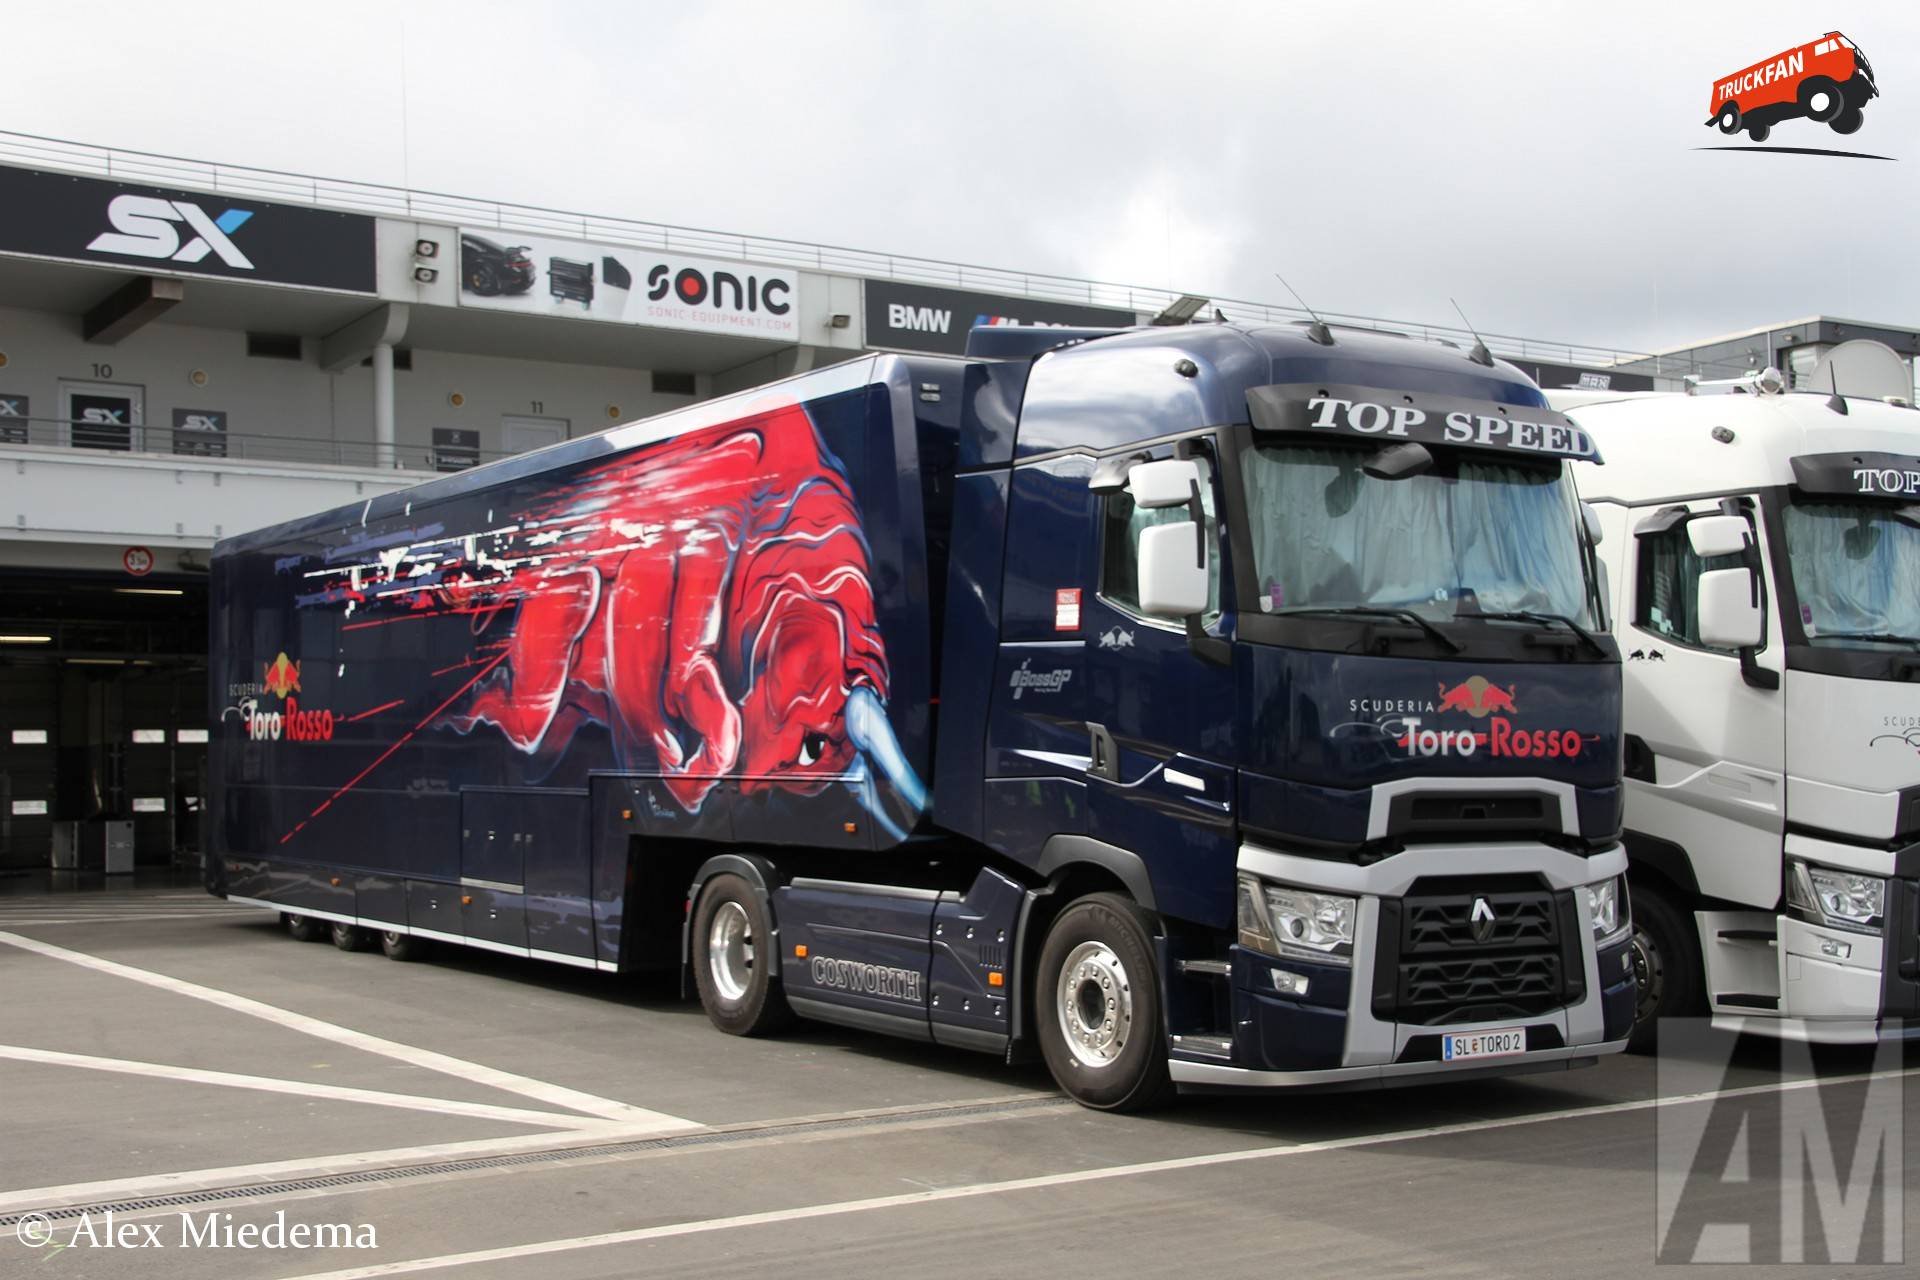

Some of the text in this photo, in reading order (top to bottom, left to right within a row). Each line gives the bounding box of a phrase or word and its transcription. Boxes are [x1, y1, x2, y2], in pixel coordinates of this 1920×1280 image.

[86, 194, 256, 270] SX
[648, 306, 792, 331] SONIC-EQUIPMENT.COM
[888, 303, 951, 334] BMW
[91, 363, 113, 379] 10
[81, 407, 124, 425] SX
[530, 400, 543, 414] 11
[182, 415, 218, 432] SX
[1308, 397, 1597, 456] TOP SPEED
[1853, 468, 1920, 493] TOP
[229, 683, 263, 697] SCUDERIA
[249, 696, 333, 741] Toro Rosso
[1350, 699, 1434, 713] SCUDERIA
[1402, 716, 1582, 758] Toro Rosso
[811, 956, 922, 1002] COSWORTH
[1455, 1038, 1470, 1056] SL
[1480, 1034, 1511, 1054] TORO
[1513, 1033, 1521, 1050] 2
